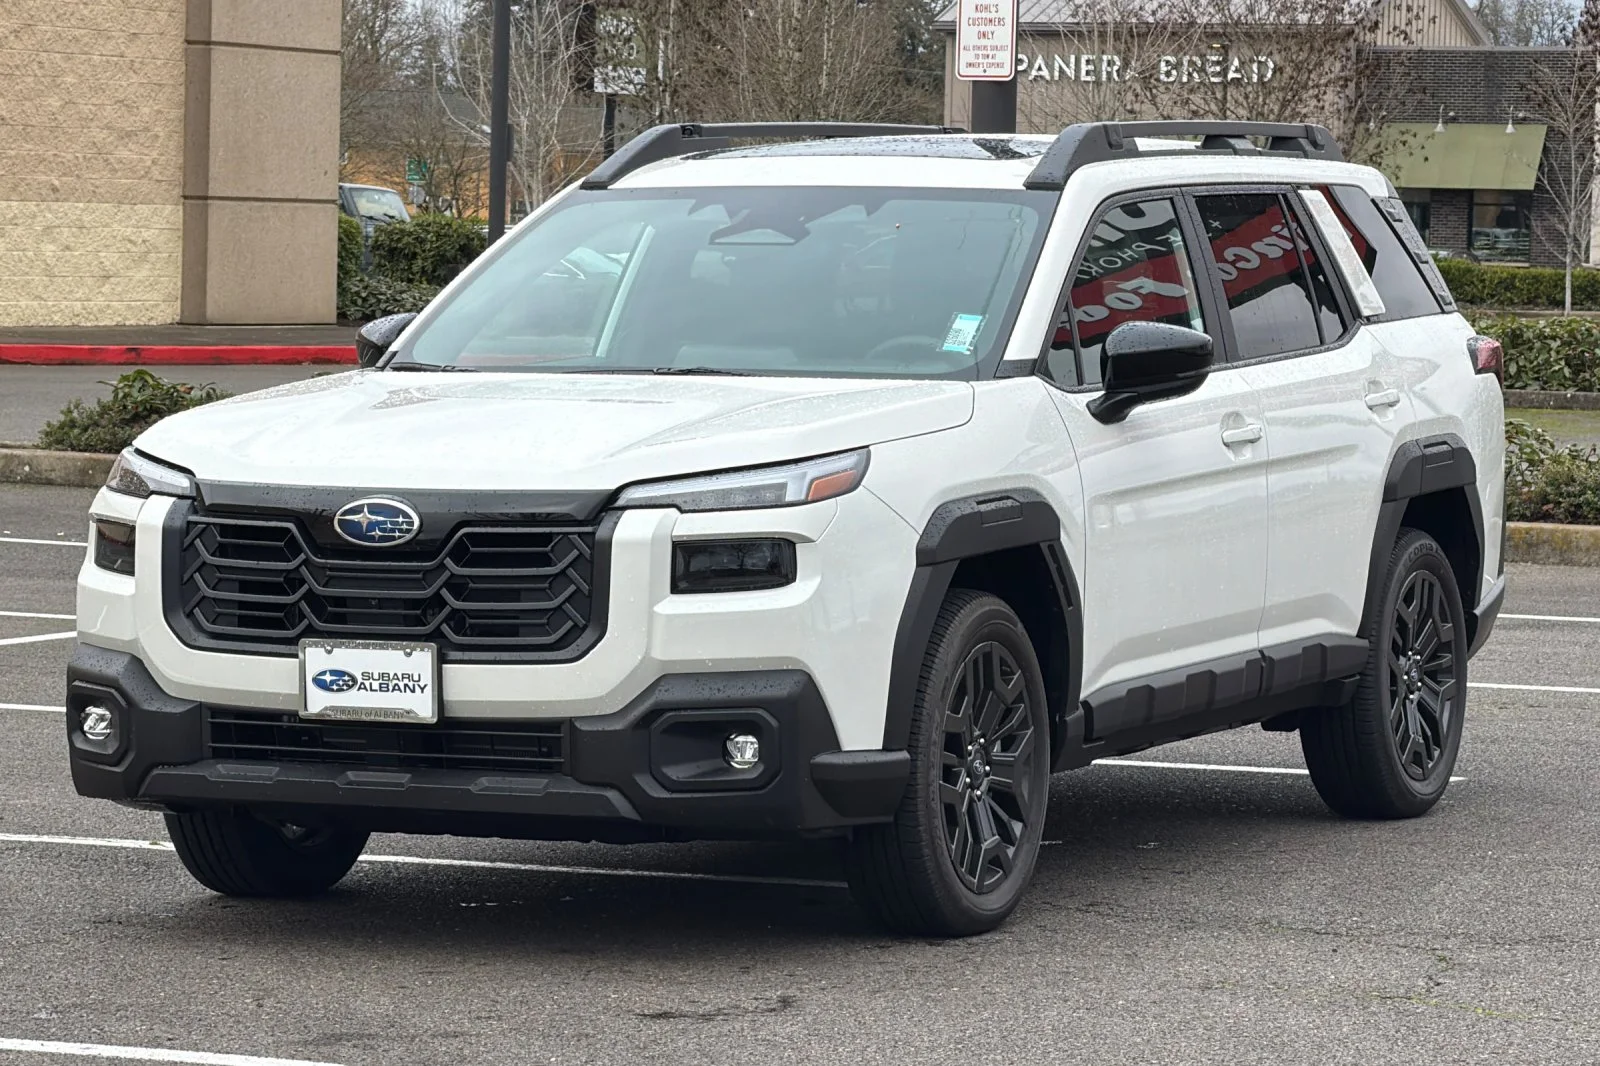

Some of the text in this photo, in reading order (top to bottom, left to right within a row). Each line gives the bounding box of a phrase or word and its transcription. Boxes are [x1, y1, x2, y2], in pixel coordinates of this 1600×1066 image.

[975, 4, 999, 13] KOHL'S
[967, 17, 1006, 27] CUSTOMERS
[977, 30, 995, 40] ONLY
[1159, 54, 1275, 83] BREAD
[361, 671, 421, 683] SUBARU
[356, 682, 428, 694] ALBANY
[332, 709, 363, 717] SUBARU
